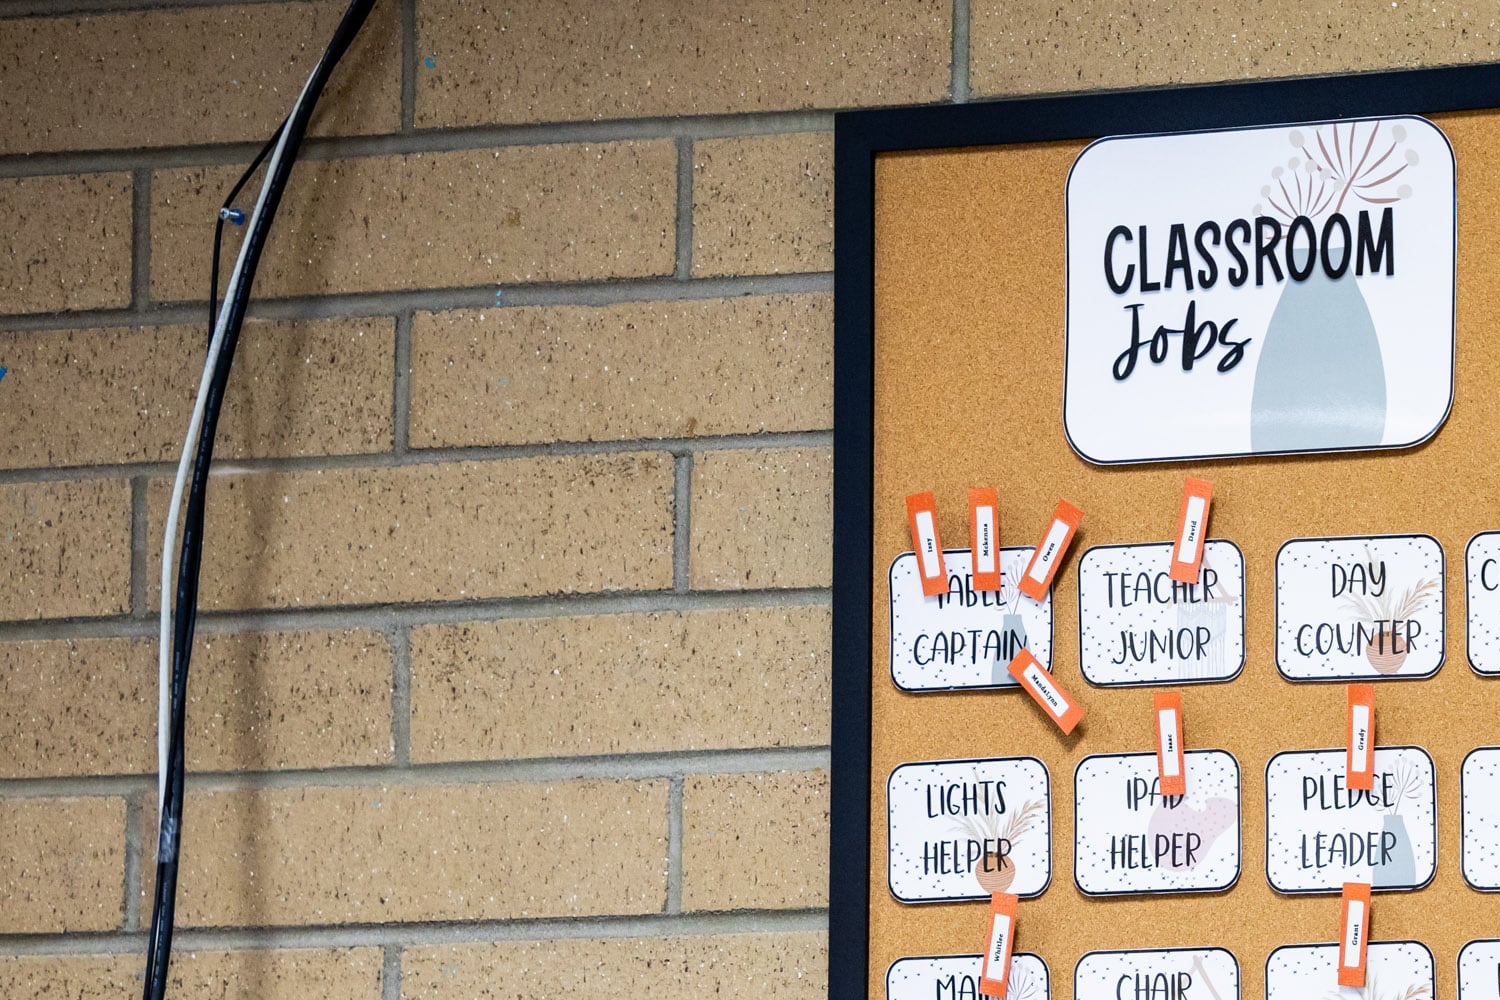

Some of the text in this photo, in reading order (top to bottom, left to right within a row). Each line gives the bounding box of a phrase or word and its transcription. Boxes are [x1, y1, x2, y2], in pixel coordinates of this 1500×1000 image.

[1104, 207, 1394, 295] CLASSROOM
[1112, 300, 1251, 381] Jobs
[1188, 520, 1197, 542] David
[1041, 541, 1056, 563] Owen
[1103, 568, 1218, 608] TEACHER
[1332, 561, 1386, 598] DAY
[914, 629, 1028, 666] CAPTAIN
[1112, 626, 1211, 664] JUNIOR
[1297, 619, 1422, 657] COUNTER
[1358, 728, 1366, 751] Grady
[926, 780, 1007, 818] LIGHTS
[922, 838, 1011, 876] HELPER
[1110, 832, 1201, 870] HELPER
[1301, 831, 1397, 869] LEADER
[1351, 922, 1359, 947] Grant
